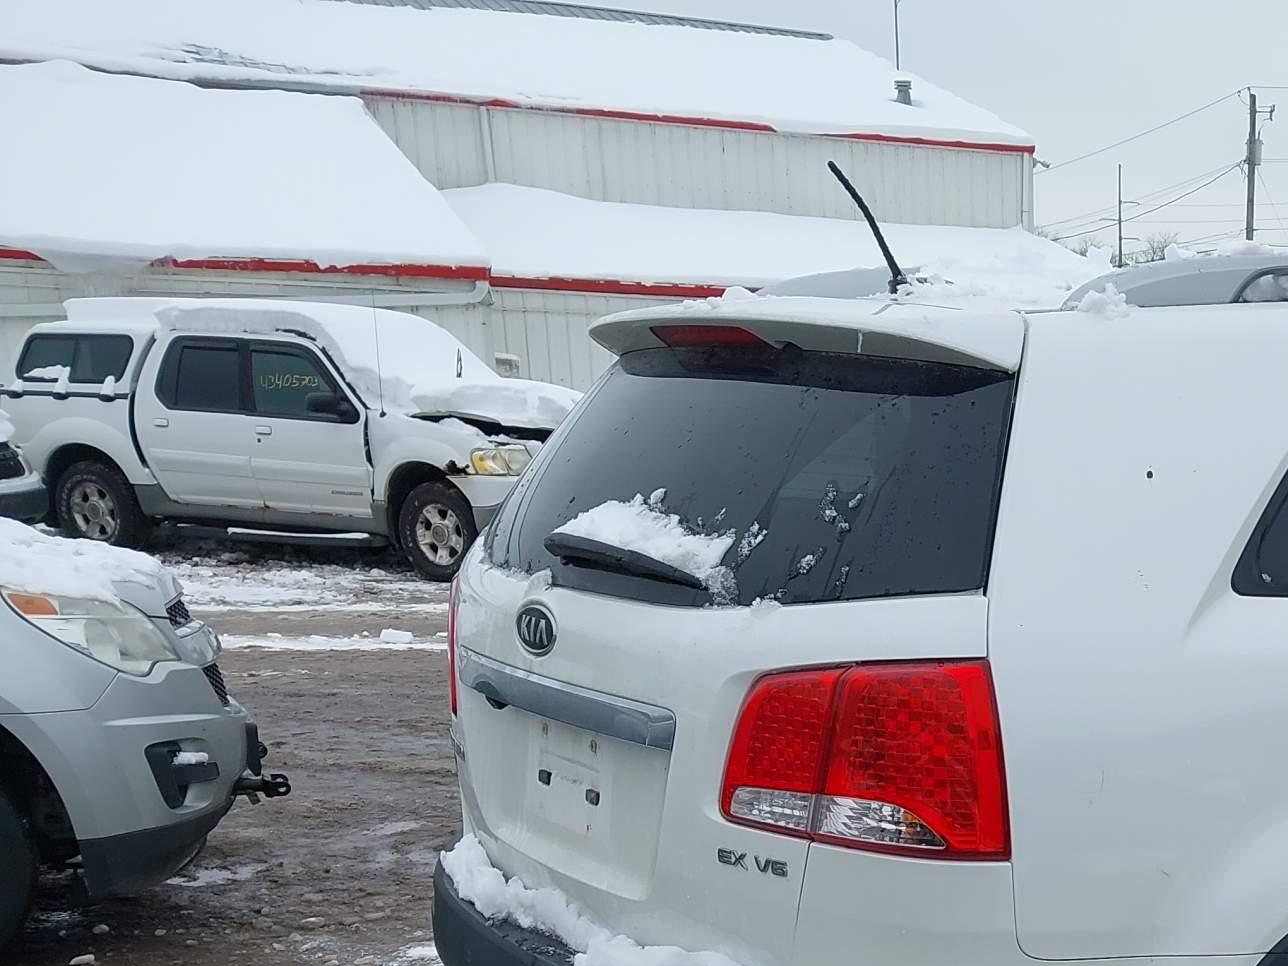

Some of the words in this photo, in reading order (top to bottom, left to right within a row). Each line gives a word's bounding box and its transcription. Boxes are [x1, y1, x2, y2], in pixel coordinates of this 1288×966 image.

[520, 614, 548, 646] KIA
[717, 847, 748, 872] EX
[753, 855, 788, 878] V6
